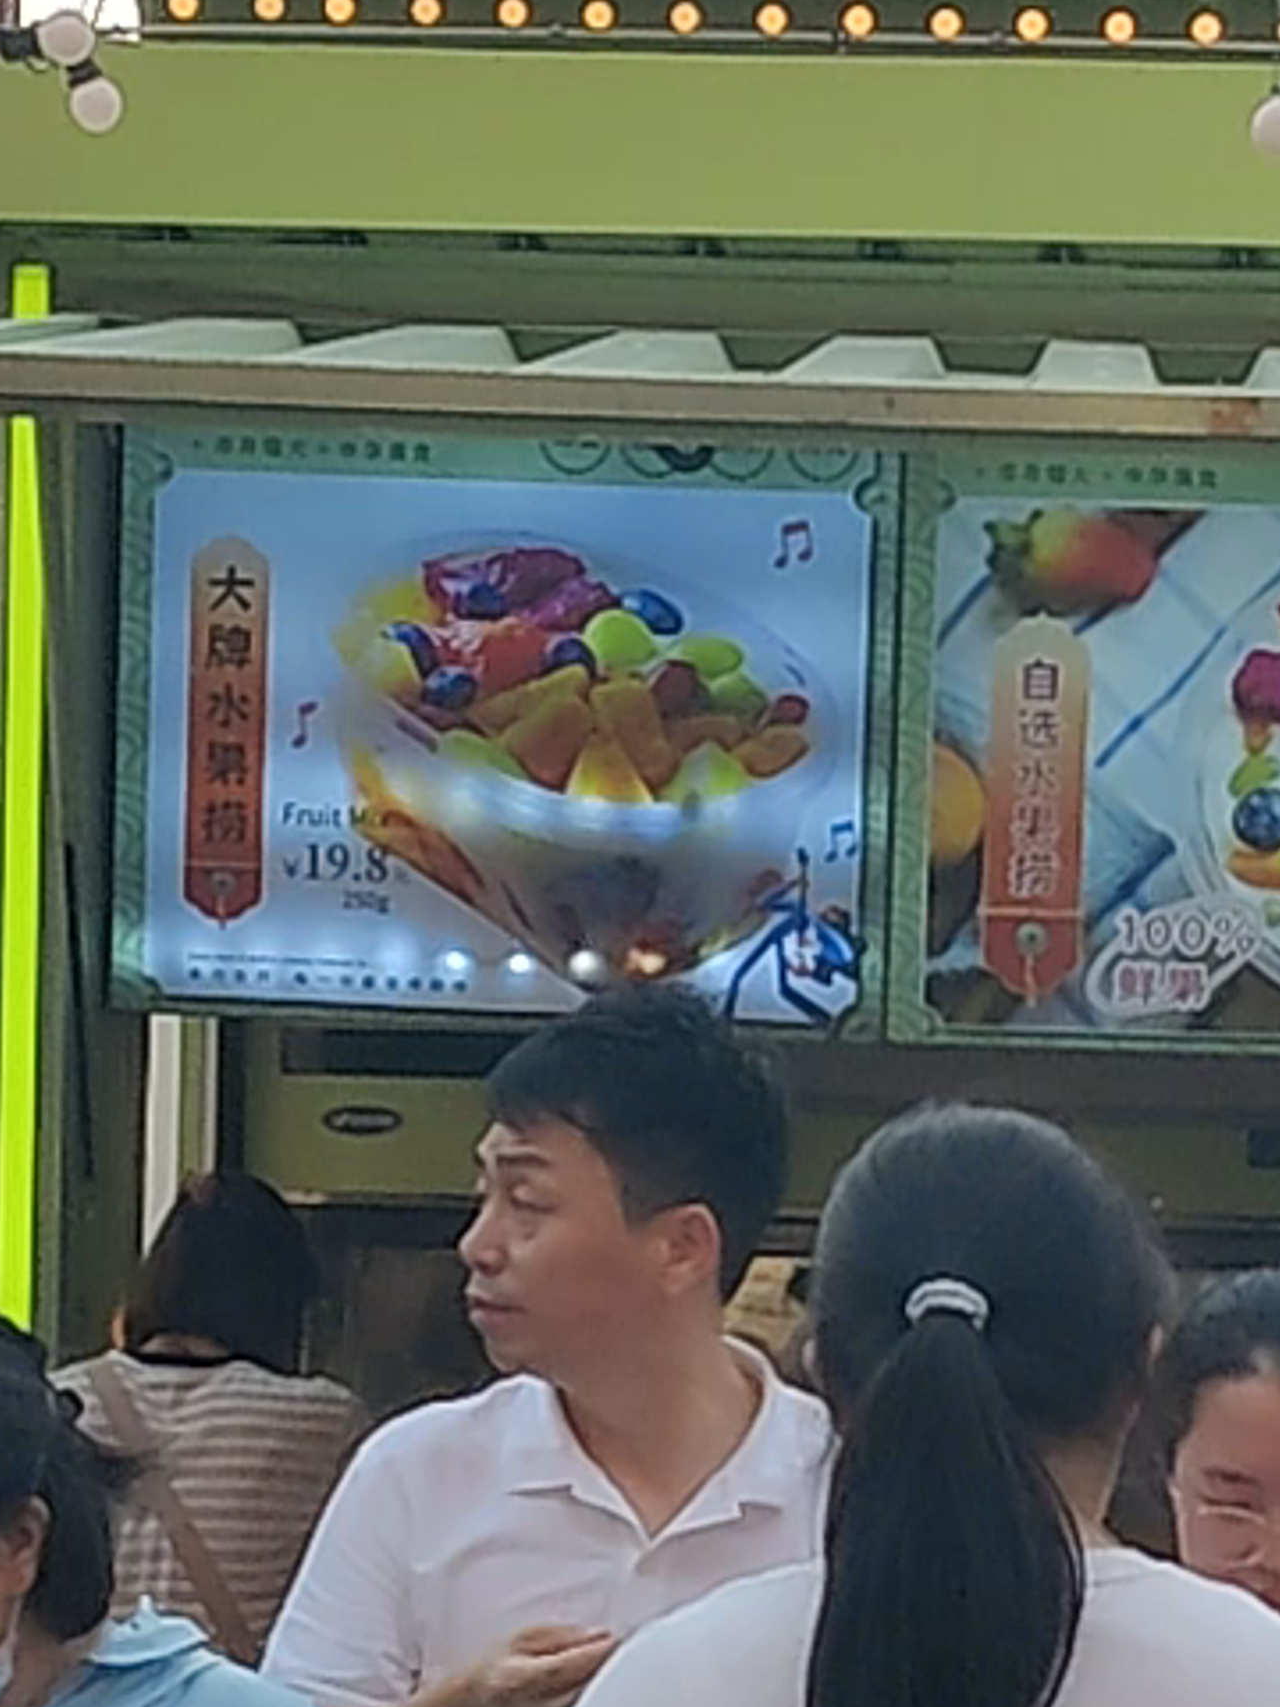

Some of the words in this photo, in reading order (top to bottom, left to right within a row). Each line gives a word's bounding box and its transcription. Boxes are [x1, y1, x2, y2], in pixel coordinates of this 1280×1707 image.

[201, 564, 256, 843] 大牌水果捞
[1016, 658, 1059, 896] 自选水果捞
[1122, 913, 1256, 955] 100%
